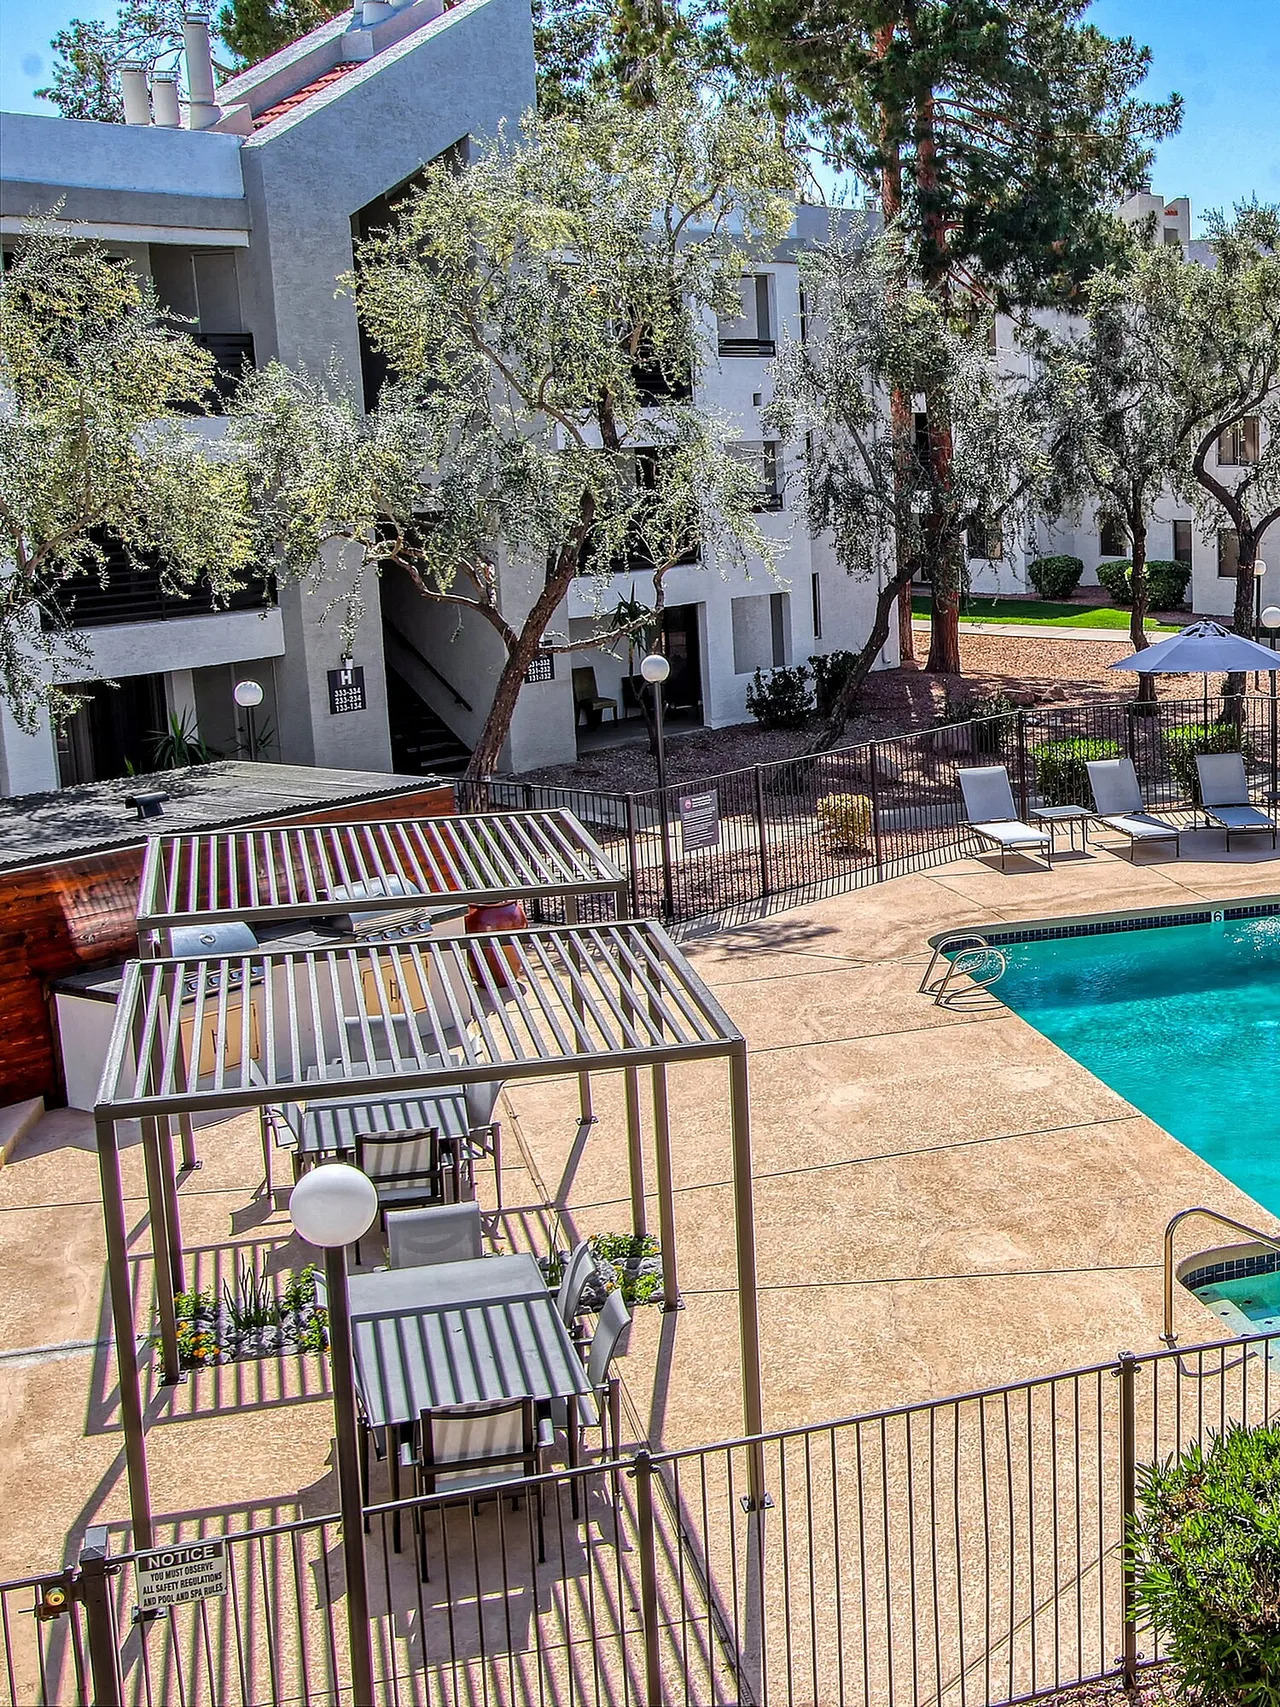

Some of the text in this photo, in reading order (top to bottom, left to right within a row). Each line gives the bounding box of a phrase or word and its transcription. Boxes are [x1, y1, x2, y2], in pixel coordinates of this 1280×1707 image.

[340, 669, 352, 686] H
[334, 687, 361, 697] 333-334
[335, 695, 362, 705] 233-234
[335, 702, 362, 712] 133-134
[1213, 910, 1223, 922] 6
[148, 1545, 215, 1569] NOTICE
[150, 1561, 214, 1582] YOU MUST OBSERVE
[142, 1571, 223, 1595] ALL SAFETY REGULATIONS
[143, 1582, 224, 1607] AND POOL AND SPA RULES
